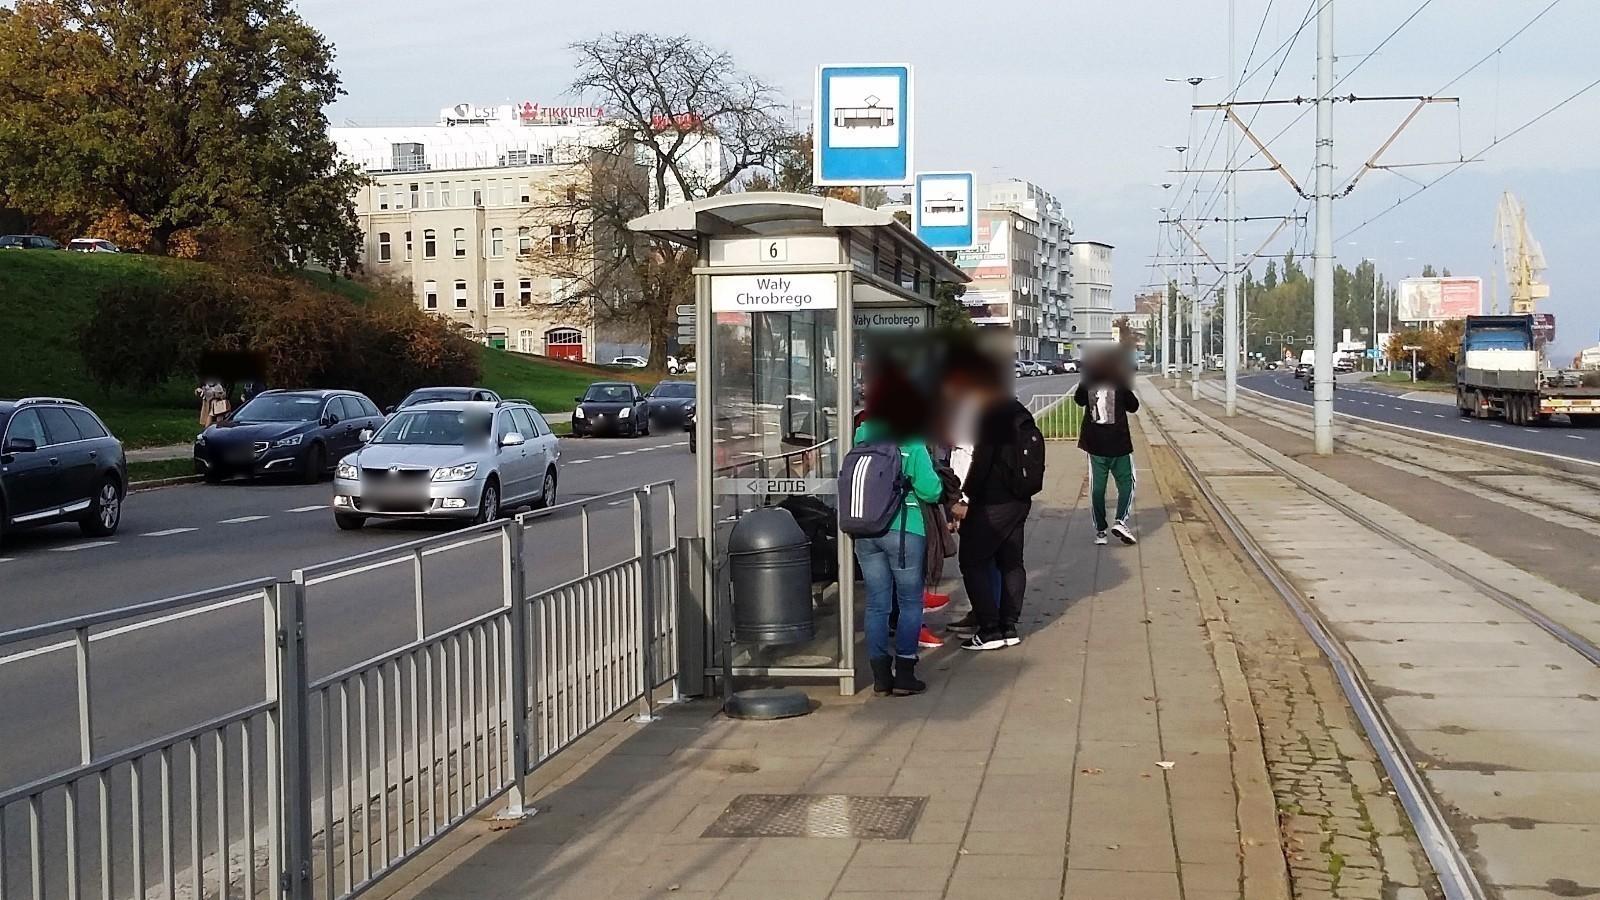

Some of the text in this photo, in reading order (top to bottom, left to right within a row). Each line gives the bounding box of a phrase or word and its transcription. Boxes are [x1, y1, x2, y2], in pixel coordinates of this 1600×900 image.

[541, 107, 605, 118] TIKKURILA
[769, 242, 778, 259] 6
[756, 277, 791, 293] Wały
[736, 292, 812, 307] Chrobrego
[873, 313, 920, 327] Chrobrego
